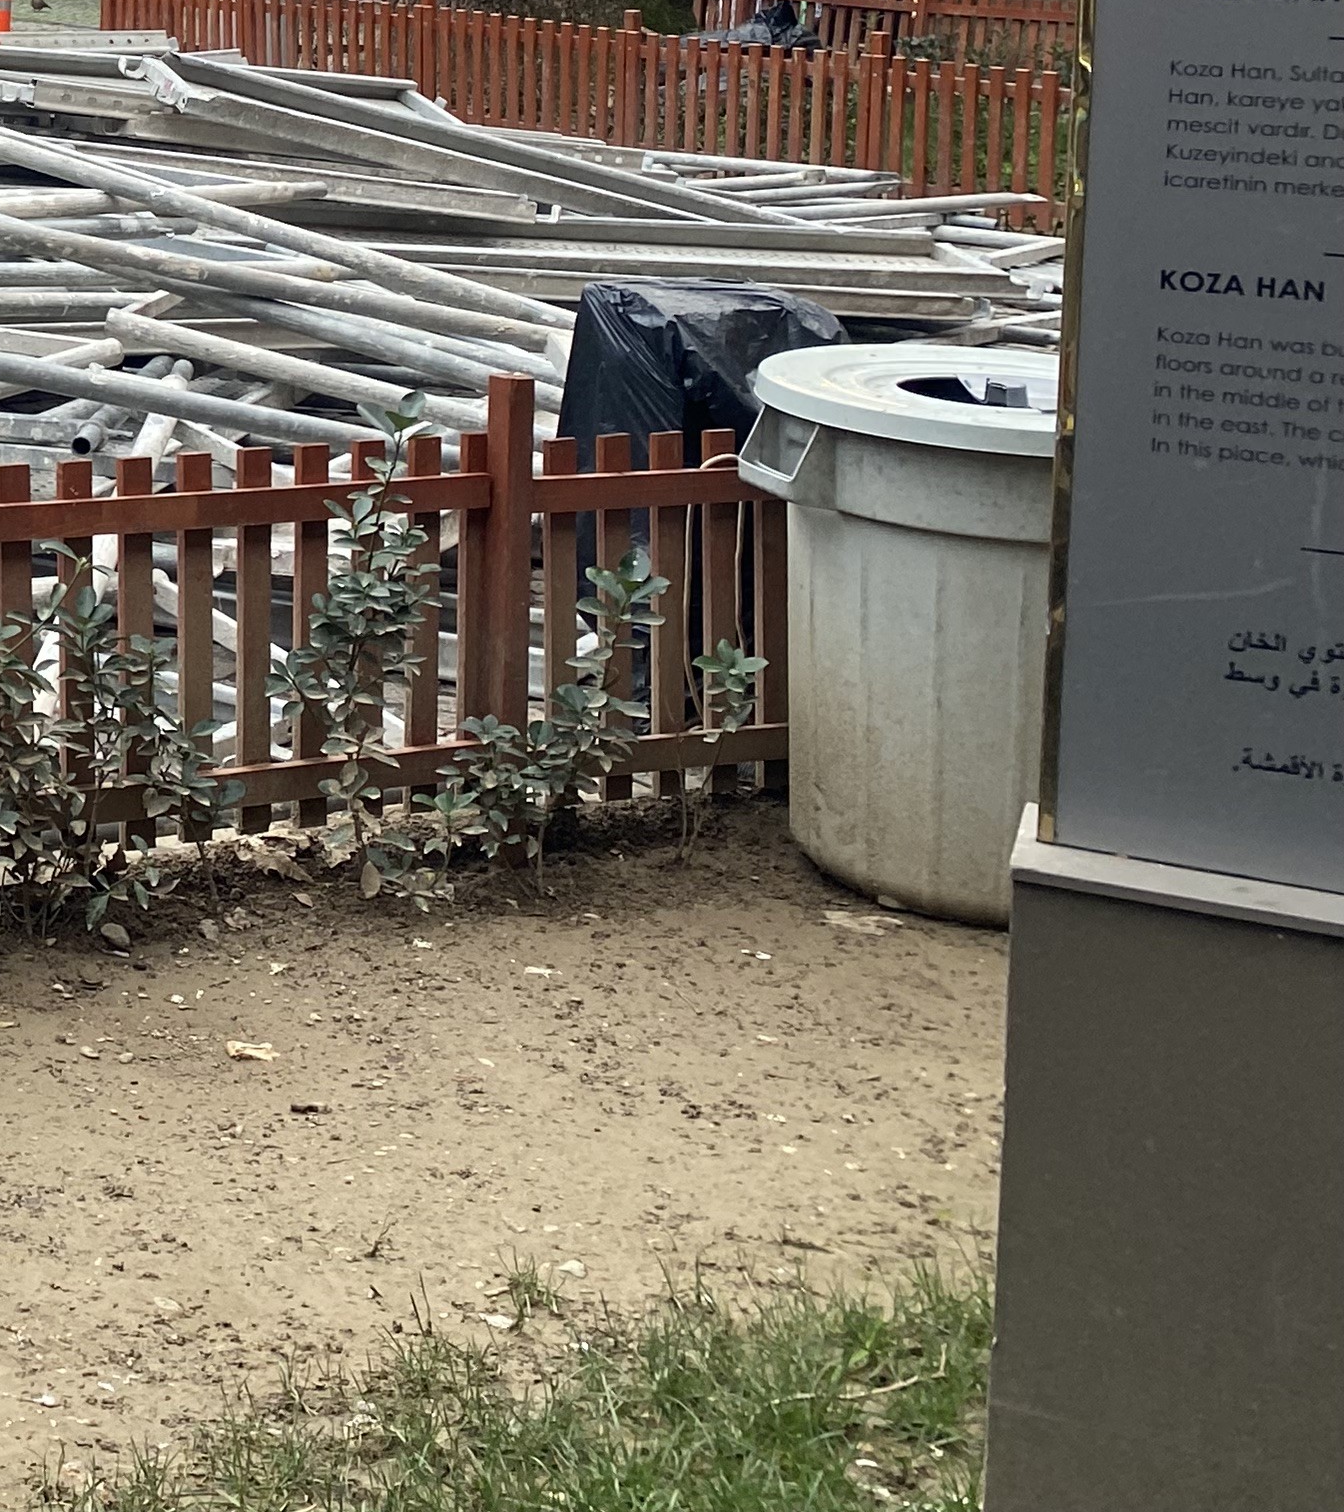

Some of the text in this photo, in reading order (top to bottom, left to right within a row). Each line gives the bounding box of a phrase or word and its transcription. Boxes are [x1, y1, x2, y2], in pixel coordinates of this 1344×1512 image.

[1169, 59, 1224, 78] Koza
[1226, 90, 1305, 111] kareye
[1166, 118, 1240, 135] mescit
[1165, 143, 1299, 166] Kuzeyindeki
[1162, 170, 1267, 194] icaretinin
[1160, 269, 1325, 303] KOZA HAN
[1156, 326, 1211, 346] Koza
[1217, 330, 1263, 350] Han
[1269, 337, 1316, 355] was
[1155, 354, 1213, 375] floors
[1219, 361, 1303, 383] around
[1309, 369, 1324, 385] a
[1153, 380, 1173, 399] in
[1179, 384, 1216, 403] the
[1221, 389, 1301, 411] middle
[1306, 397, 1330, 413] of
[1152, 409, 1171, 428] in
[1178, 411, 1214, 431] the
[1282, 421, 1322, 442] The
[1151, 438, 1170, 454] In
[1177, 439, 1213, 459] this
